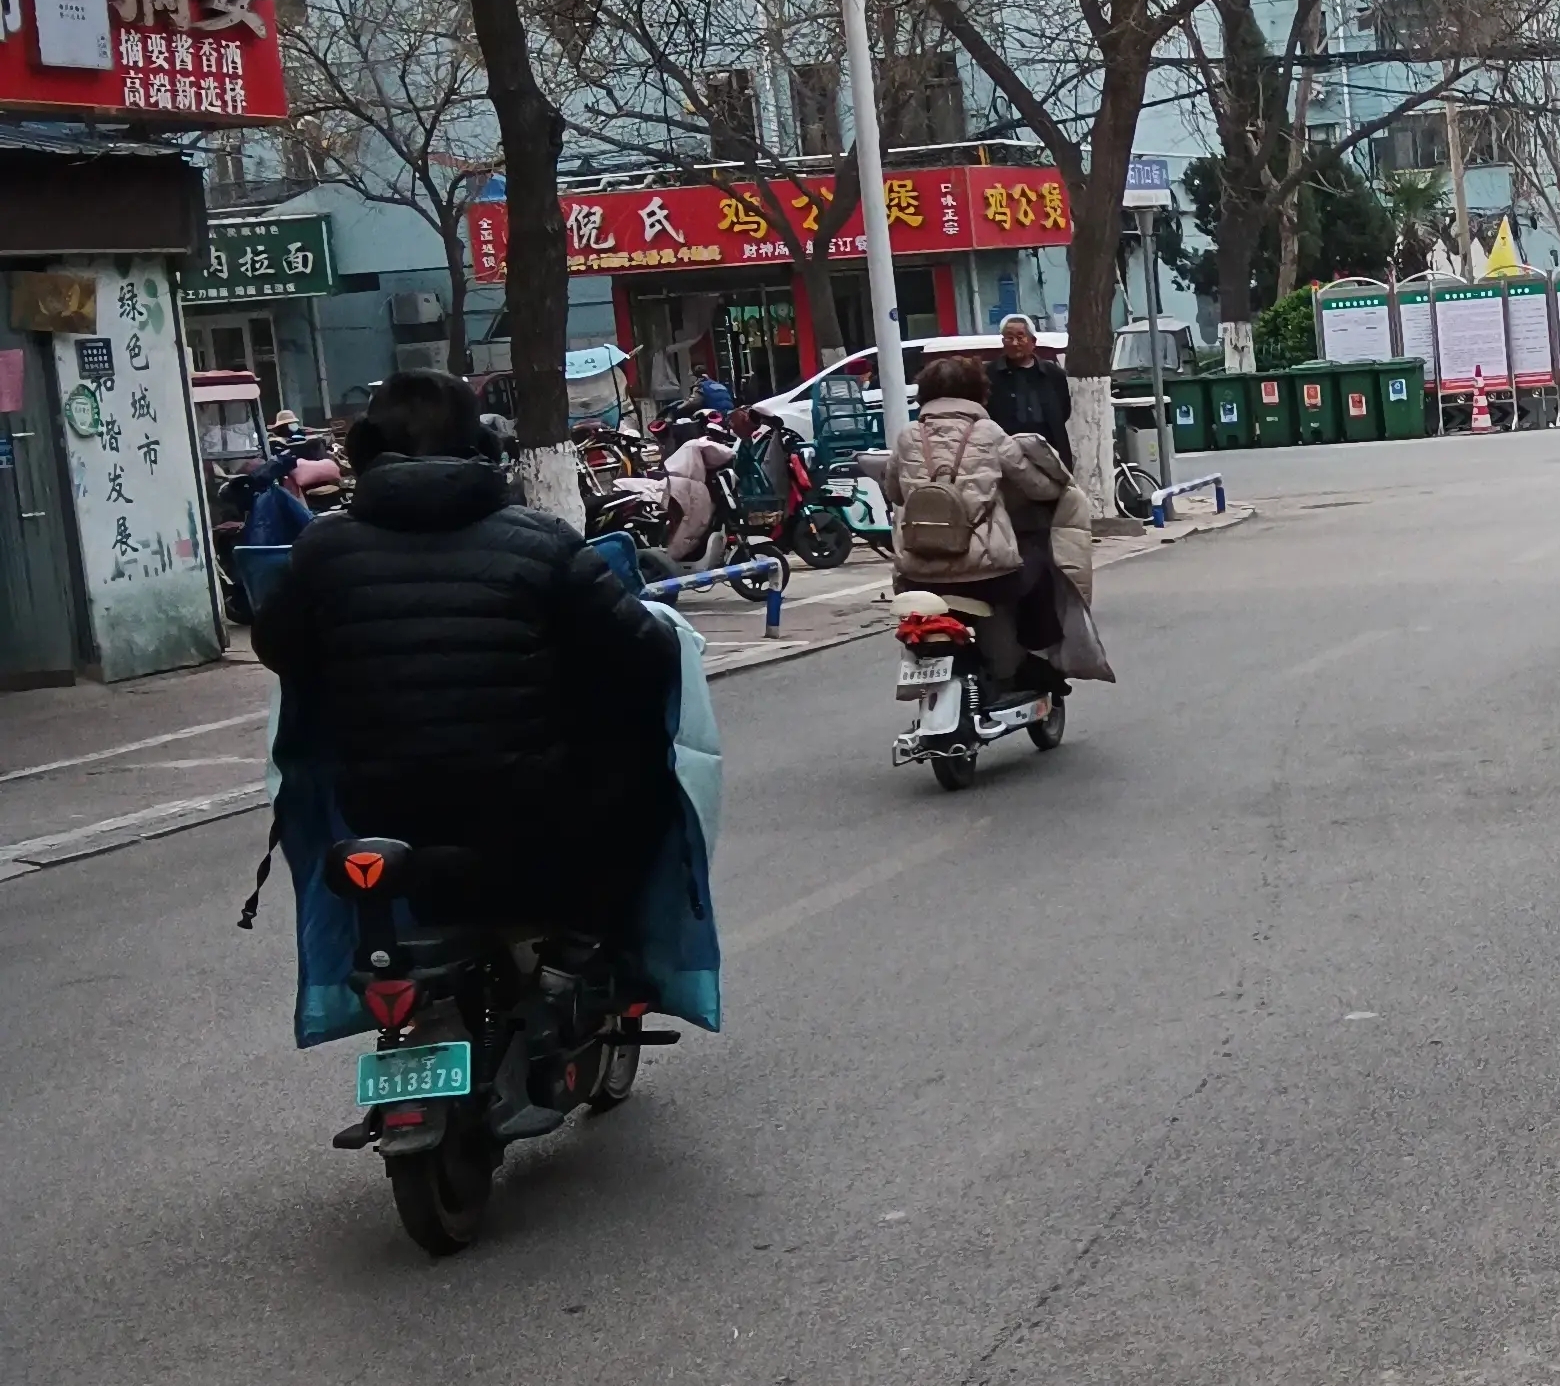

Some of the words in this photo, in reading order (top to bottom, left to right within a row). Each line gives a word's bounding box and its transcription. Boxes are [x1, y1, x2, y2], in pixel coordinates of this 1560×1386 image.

[119, 28, 244, 77] 摘要酱香酒
[121, 69, 248, 115] 高端新选择
[983, 181, 1067, 230] 鸡公煲
[116, 282, 161, 476] 绿色城市
[89, 373, 140, 557] 和谐发展
